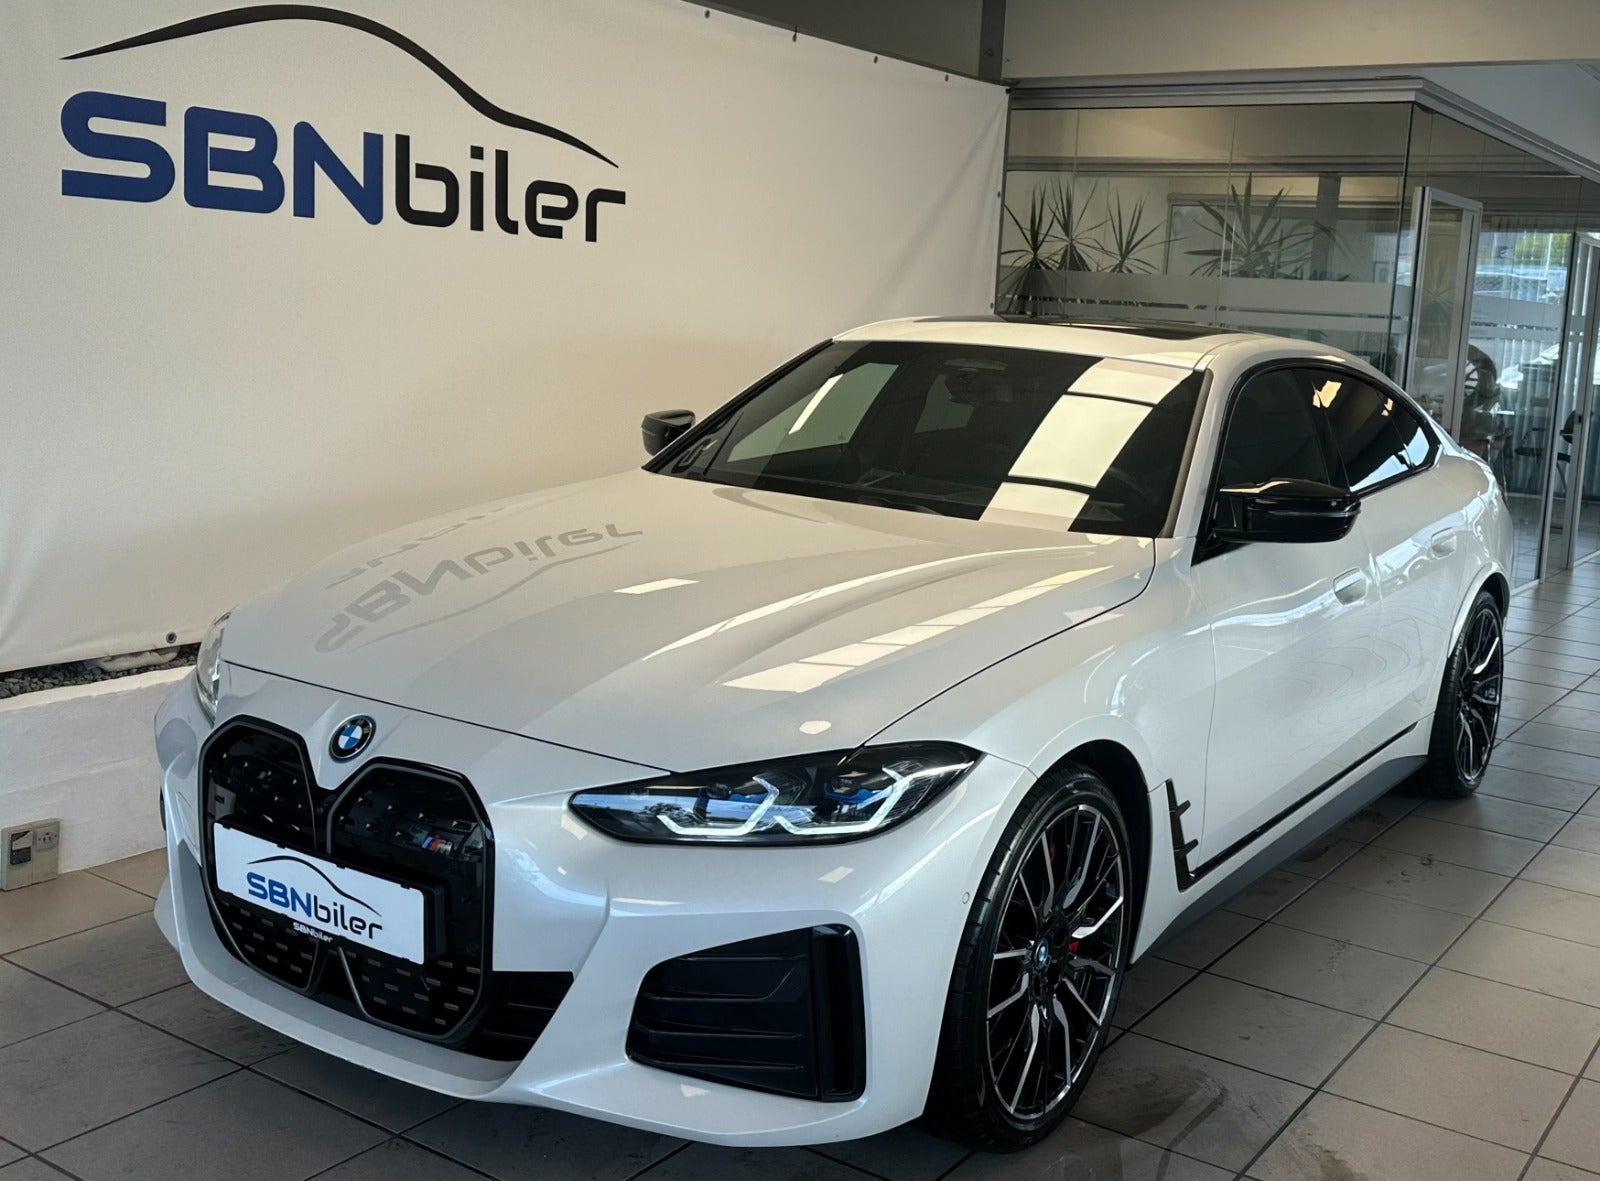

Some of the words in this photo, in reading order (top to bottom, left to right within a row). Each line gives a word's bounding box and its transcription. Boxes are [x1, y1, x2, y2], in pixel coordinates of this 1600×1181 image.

[61, 91, 625, 242] SBNbiler
[247, 872, 383, 939] SBNbiler
[293, 922, 332, 942] SBNbiler
